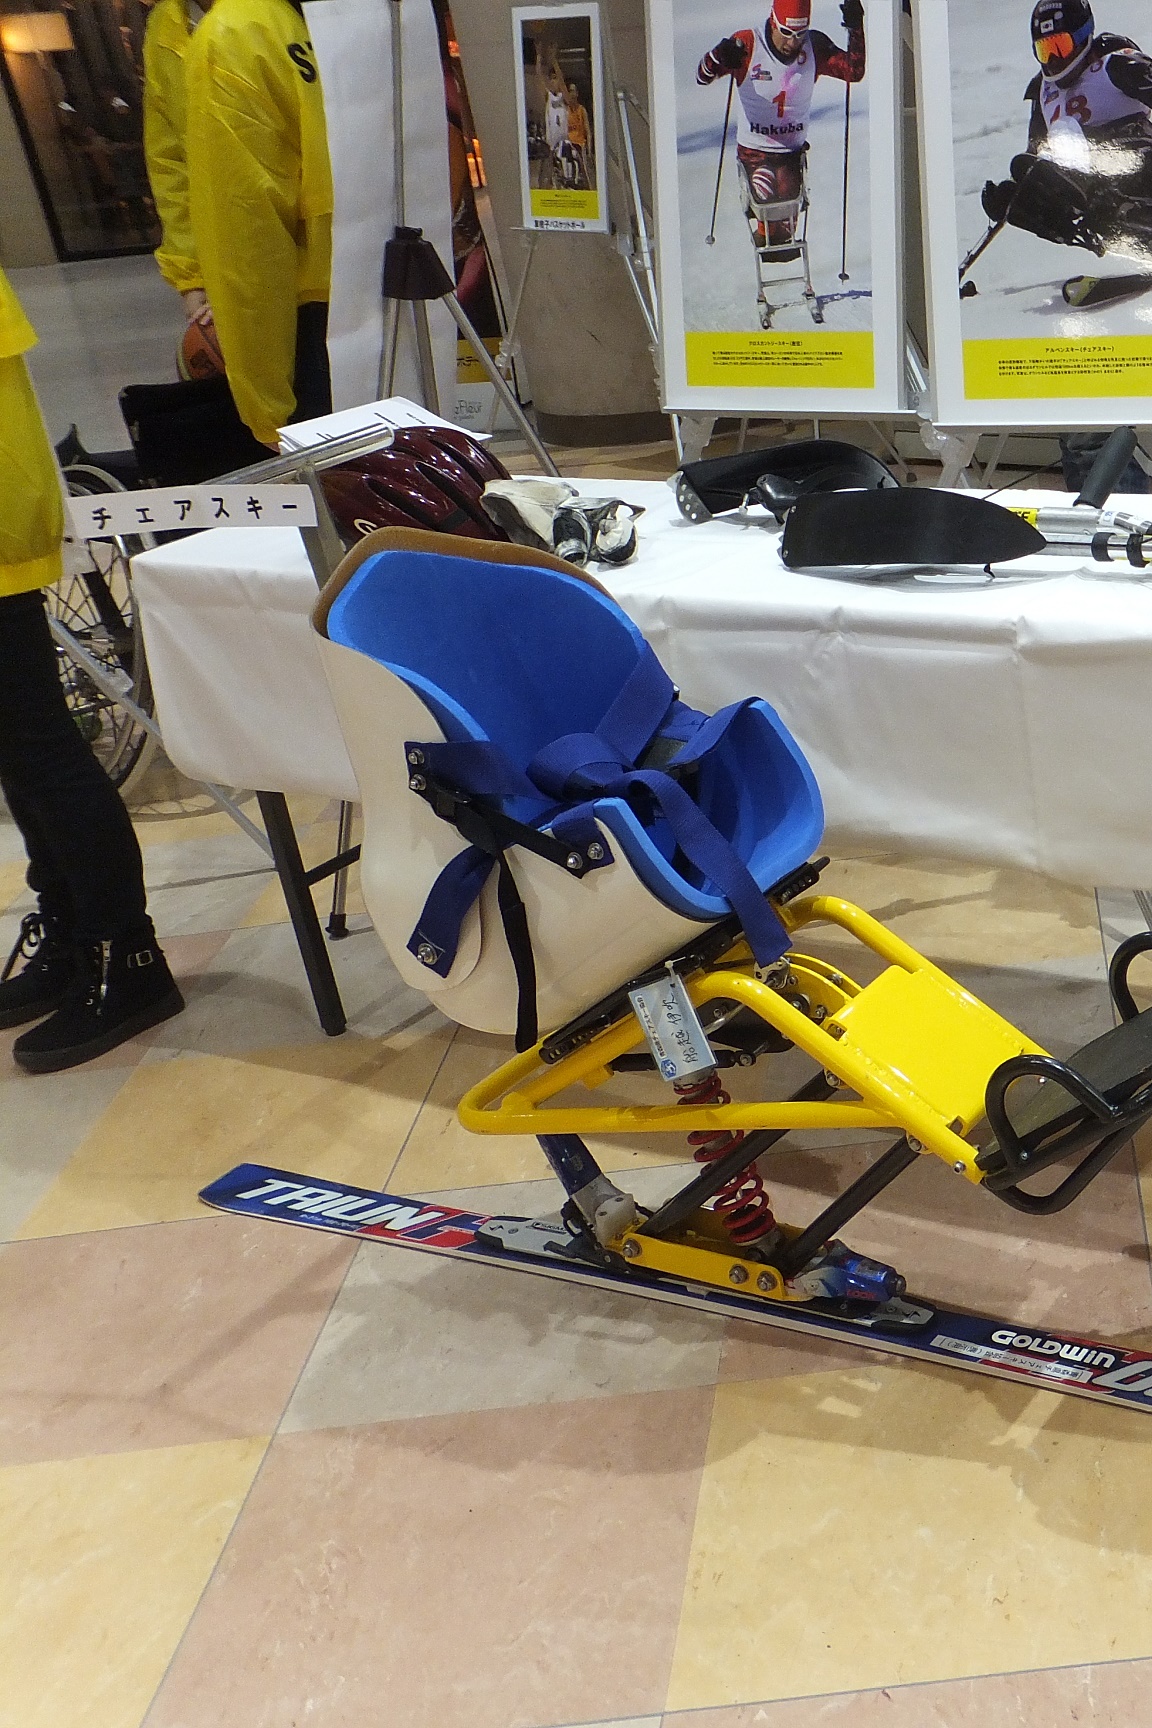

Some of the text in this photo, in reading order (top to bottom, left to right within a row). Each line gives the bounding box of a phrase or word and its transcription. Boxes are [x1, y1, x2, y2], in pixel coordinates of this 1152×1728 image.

[286, 41, 317, 84] S
[771, 90, 787, 118] 1
[749, 121, 805, 135] Hakuba
[235, 1178, 446, 1231] TRIUN
